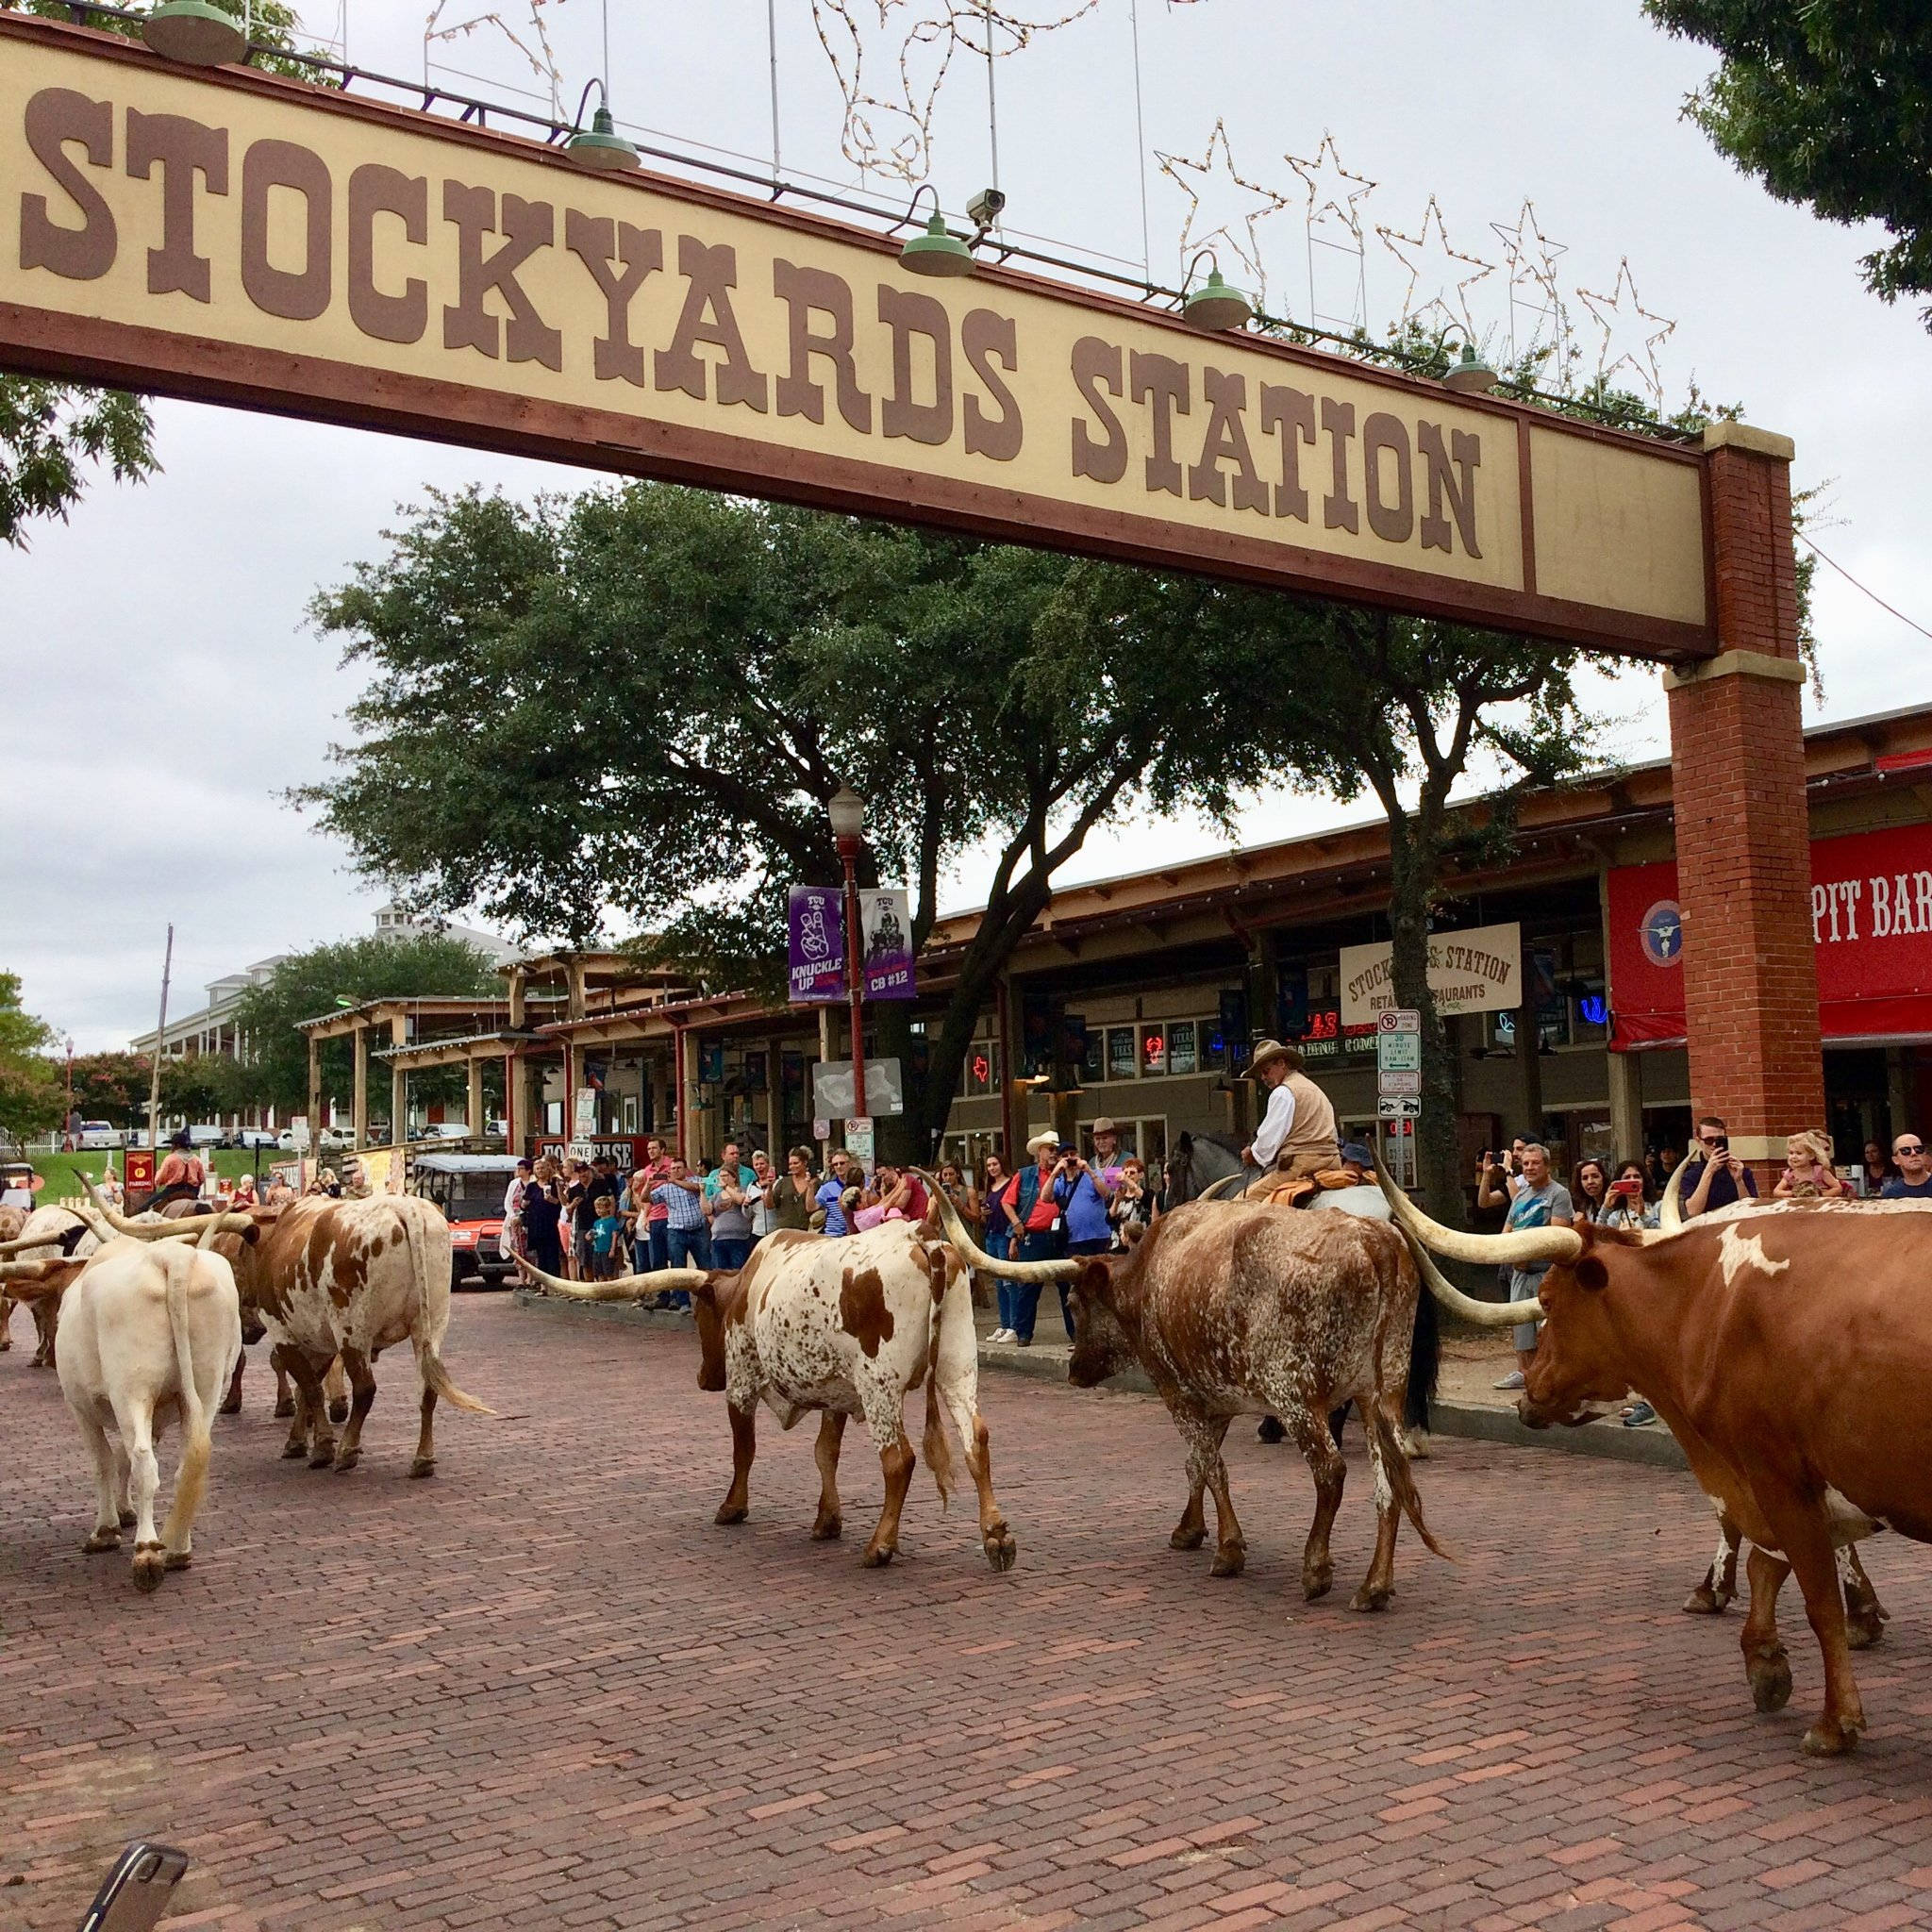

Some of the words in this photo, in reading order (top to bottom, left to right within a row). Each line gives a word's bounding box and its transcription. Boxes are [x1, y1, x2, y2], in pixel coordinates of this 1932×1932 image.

[20, 87, 1023, 461] STOCKYARDS
[1071, 335, 1483, 560] STATION
[807, 895, 825, 906] TCU
[875, 896, 894, 906] TCU
[1811, 879, 1861, 943] PIT
[1869, 871, 1932, 937] BAR
[791, 958, 842, 980] KNUCKLE
[1445, 945, 1511, 986] STATION
[798, 976, 814, 991] UP
[871, 975, 886, 991] CB
[888, 970, 908, 988] #12
[570, 1146, 589, 1158] ONE
